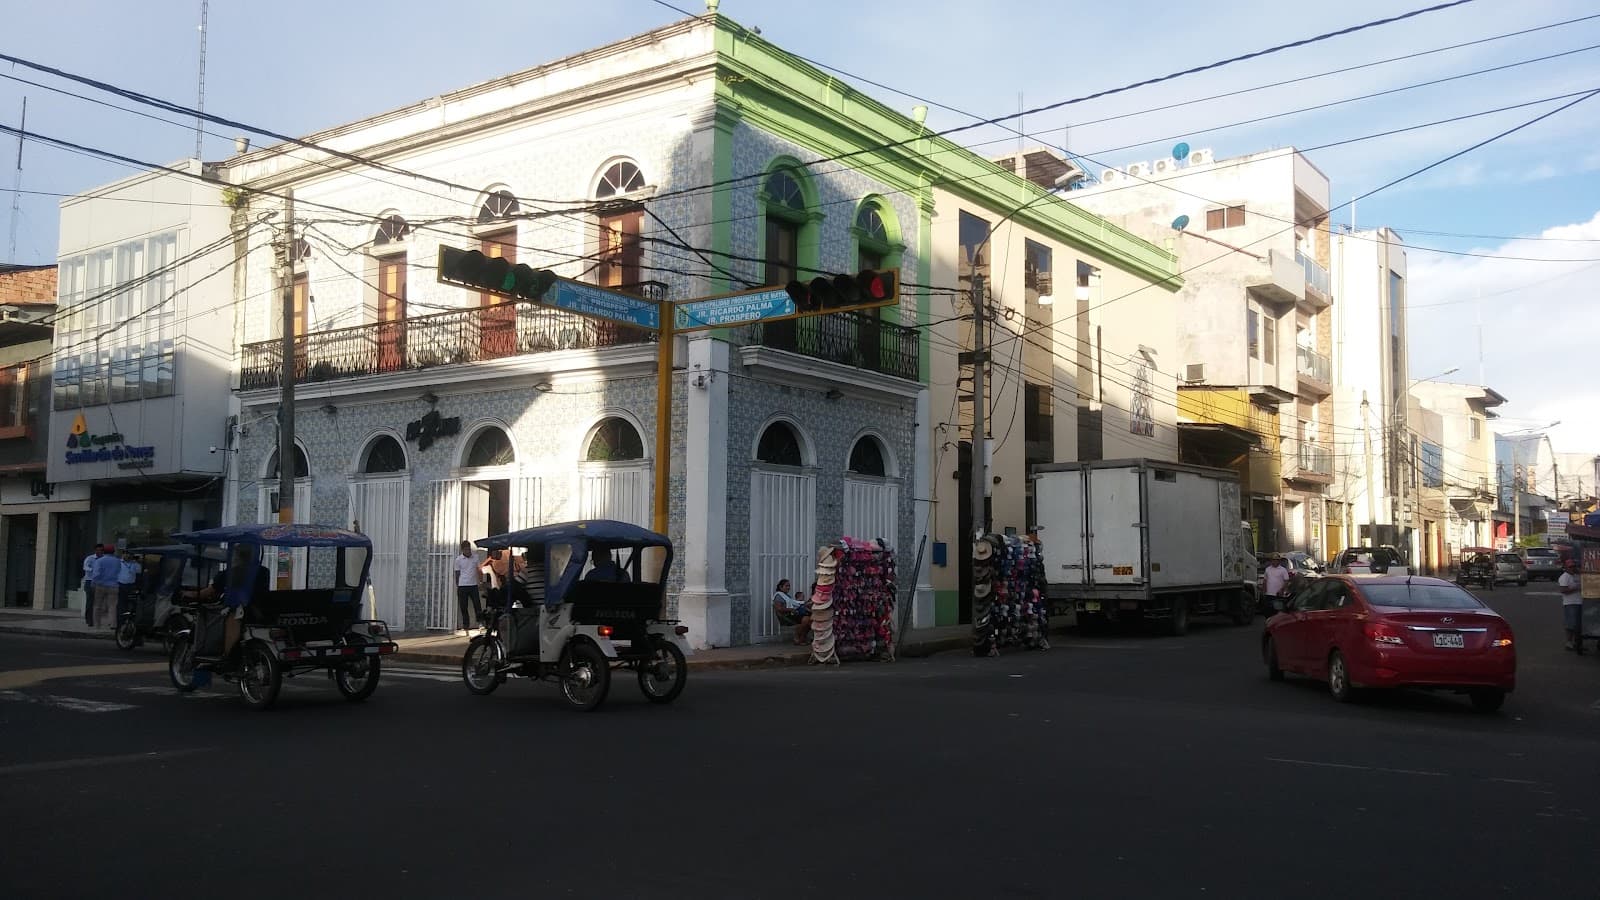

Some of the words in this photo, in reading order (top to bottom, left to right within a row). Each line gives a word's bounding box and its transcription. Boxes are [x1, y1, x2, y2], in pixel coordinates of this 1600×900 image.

[581, 304, 614, 319] RICARDO
[614, 312, 638, 324] PALMA
[697, 310, 709, 319] JR.
[710, 305, 744, 316] RICARDO
[746, 301, 773, 312] PALMA
[719, 311, 760, 323] PROSPERO
[277, 616, 328, 626] HONDA
